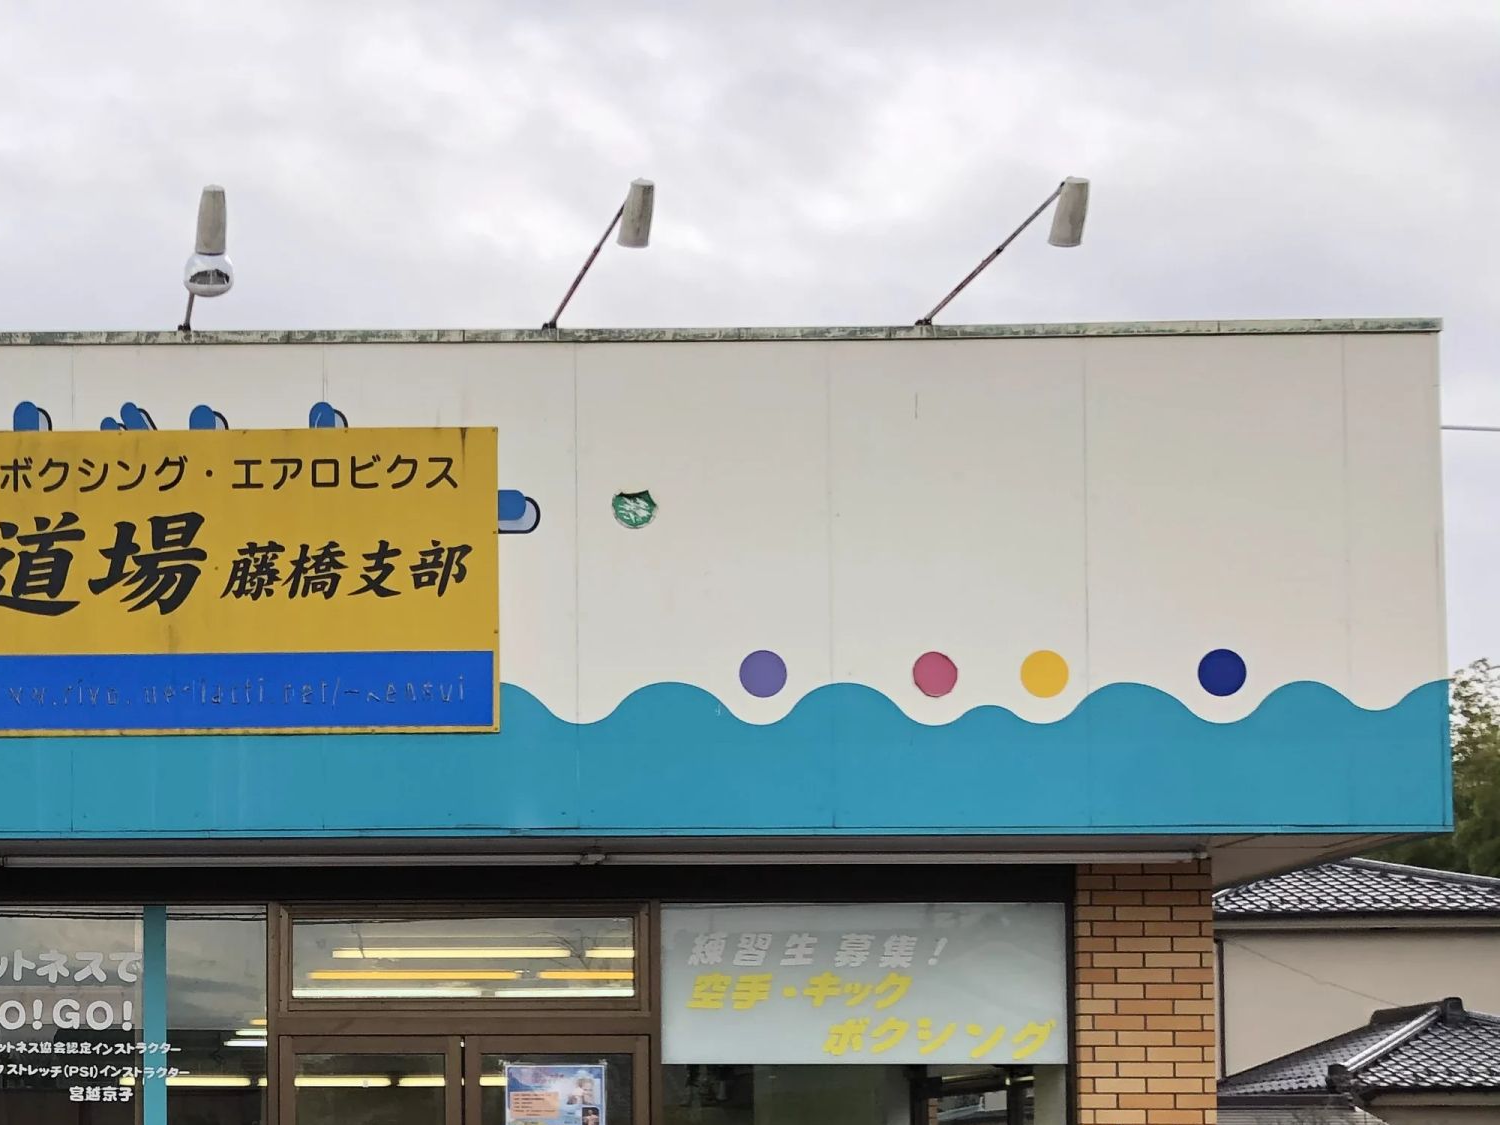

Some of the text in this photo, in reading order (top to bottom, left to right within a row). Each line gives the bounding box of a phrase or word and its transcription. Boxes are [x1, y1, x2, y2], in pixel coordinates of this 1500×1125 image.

[219, 538, 473, 602] 藤橋支部
[687, 930, 949, 968] 練習生募集!
[686, 971, 913, 1011] 空手・キック
[822, 1017, 1057, 1060] ボクシング
[68, 1085, 135, 1102] 宮越京子
